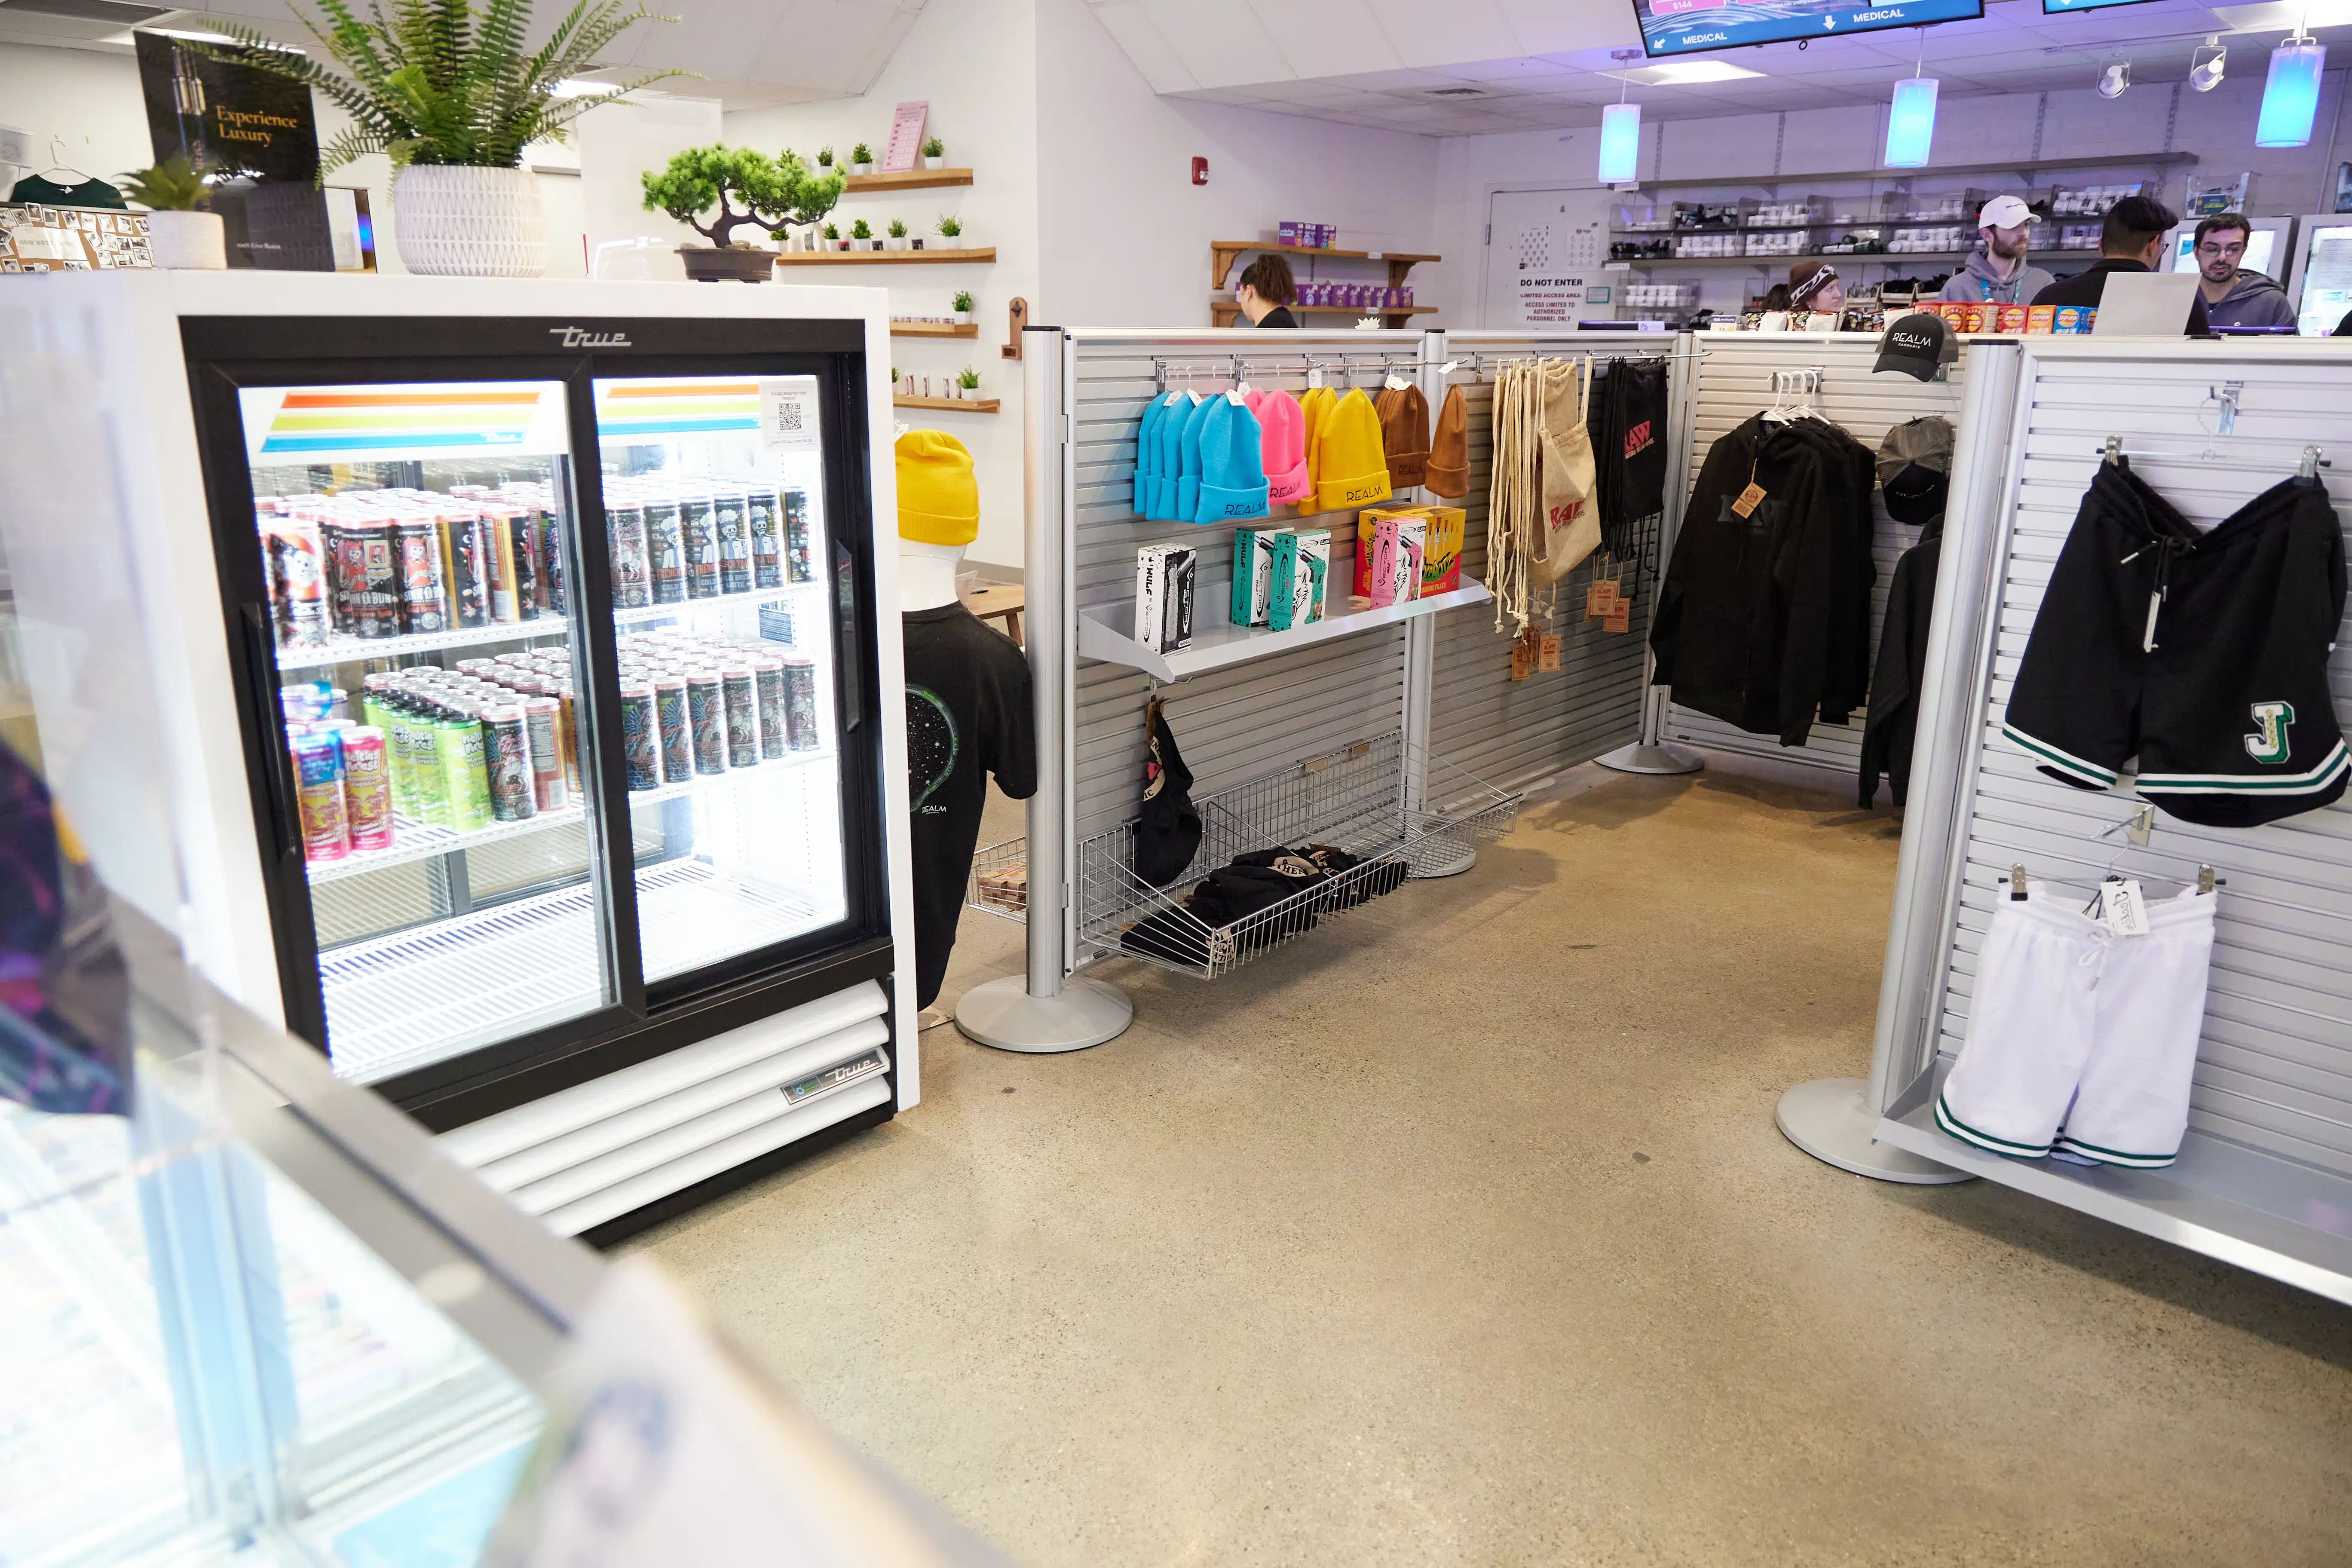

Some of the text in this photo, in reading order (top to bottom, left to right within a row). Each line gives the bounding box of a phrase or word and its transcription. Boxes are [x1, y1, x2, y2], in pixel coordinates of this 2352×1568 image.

[1672, 1, 1692, 10] $144
[1853, 9, 1905, 22] MEDICAL
[1682, 32, 1728, 45] MEDICAL
[216, 105, 299, 128] Experience
[219, 123, 272, 147] Luxury
[549, 325, 632, 347] True
[1892, 332, 1931, 347] REALM
[1270, 478, 1302, 498] REALM
[1346, 485, 1384, 502] REALM
[1225, 499, 1266, 516] REALM
[2243, 700, 2295, 764] J
[922, 805, 946, 814] REALM
[825, 1060, 879, 1082] True
